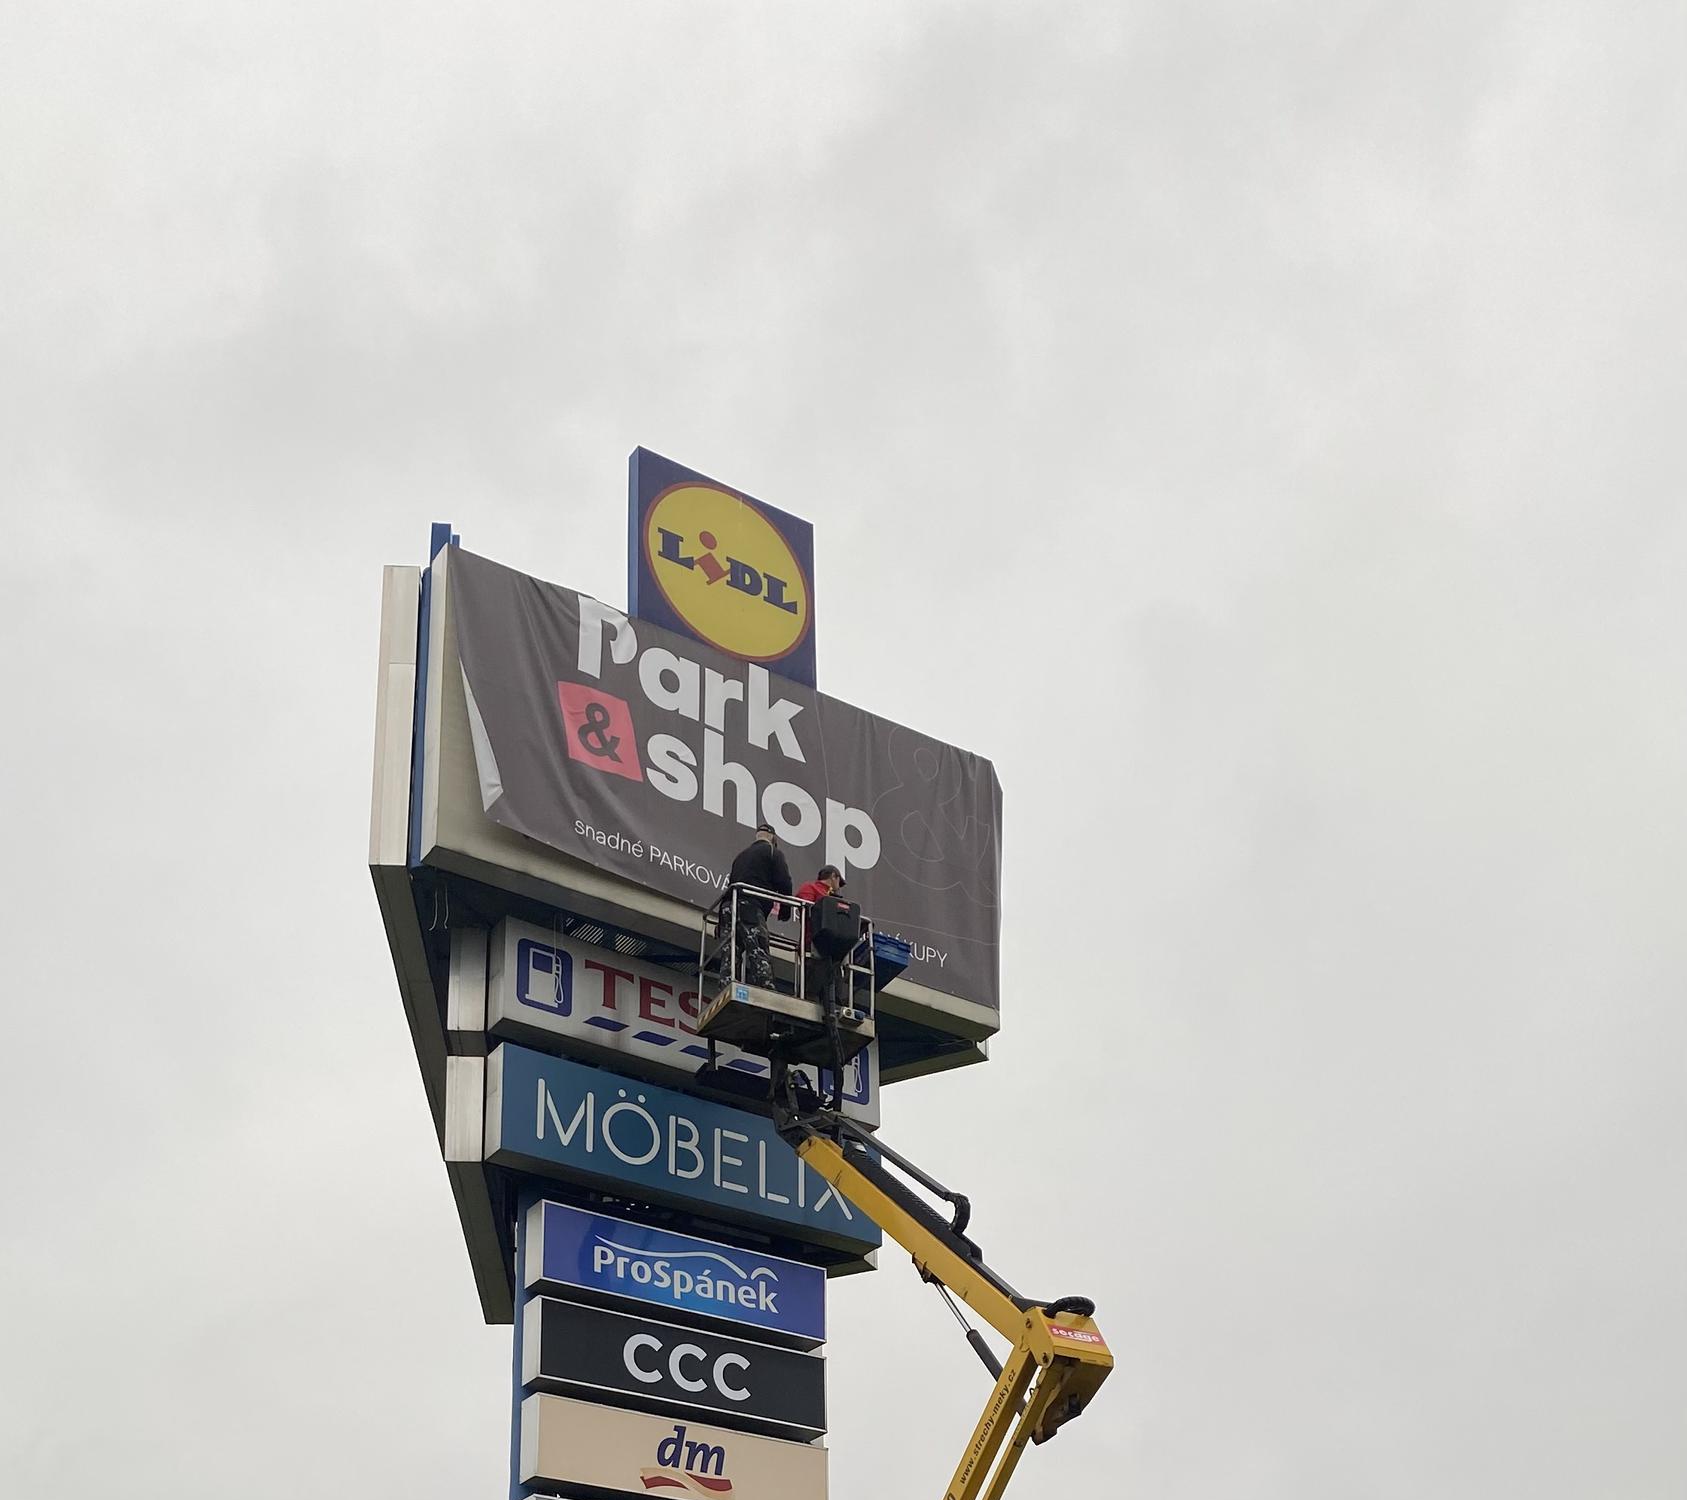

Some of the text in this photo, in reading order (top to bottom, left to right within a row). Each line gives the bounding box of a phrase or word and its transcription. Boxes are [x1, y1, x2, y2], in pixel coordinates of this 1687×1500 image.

[577, 703, 881, 880] & shop
[574, 819, 645, 859] snadné
[650, 844, 732, 891] PARKOVÁ
[585, 959, 713, 1037] TES
[593, 1245, 779, 1314] ProSpánek
[623, 1333, 752, 1401] CCC
[656, 1424, 726, 1477] dm
